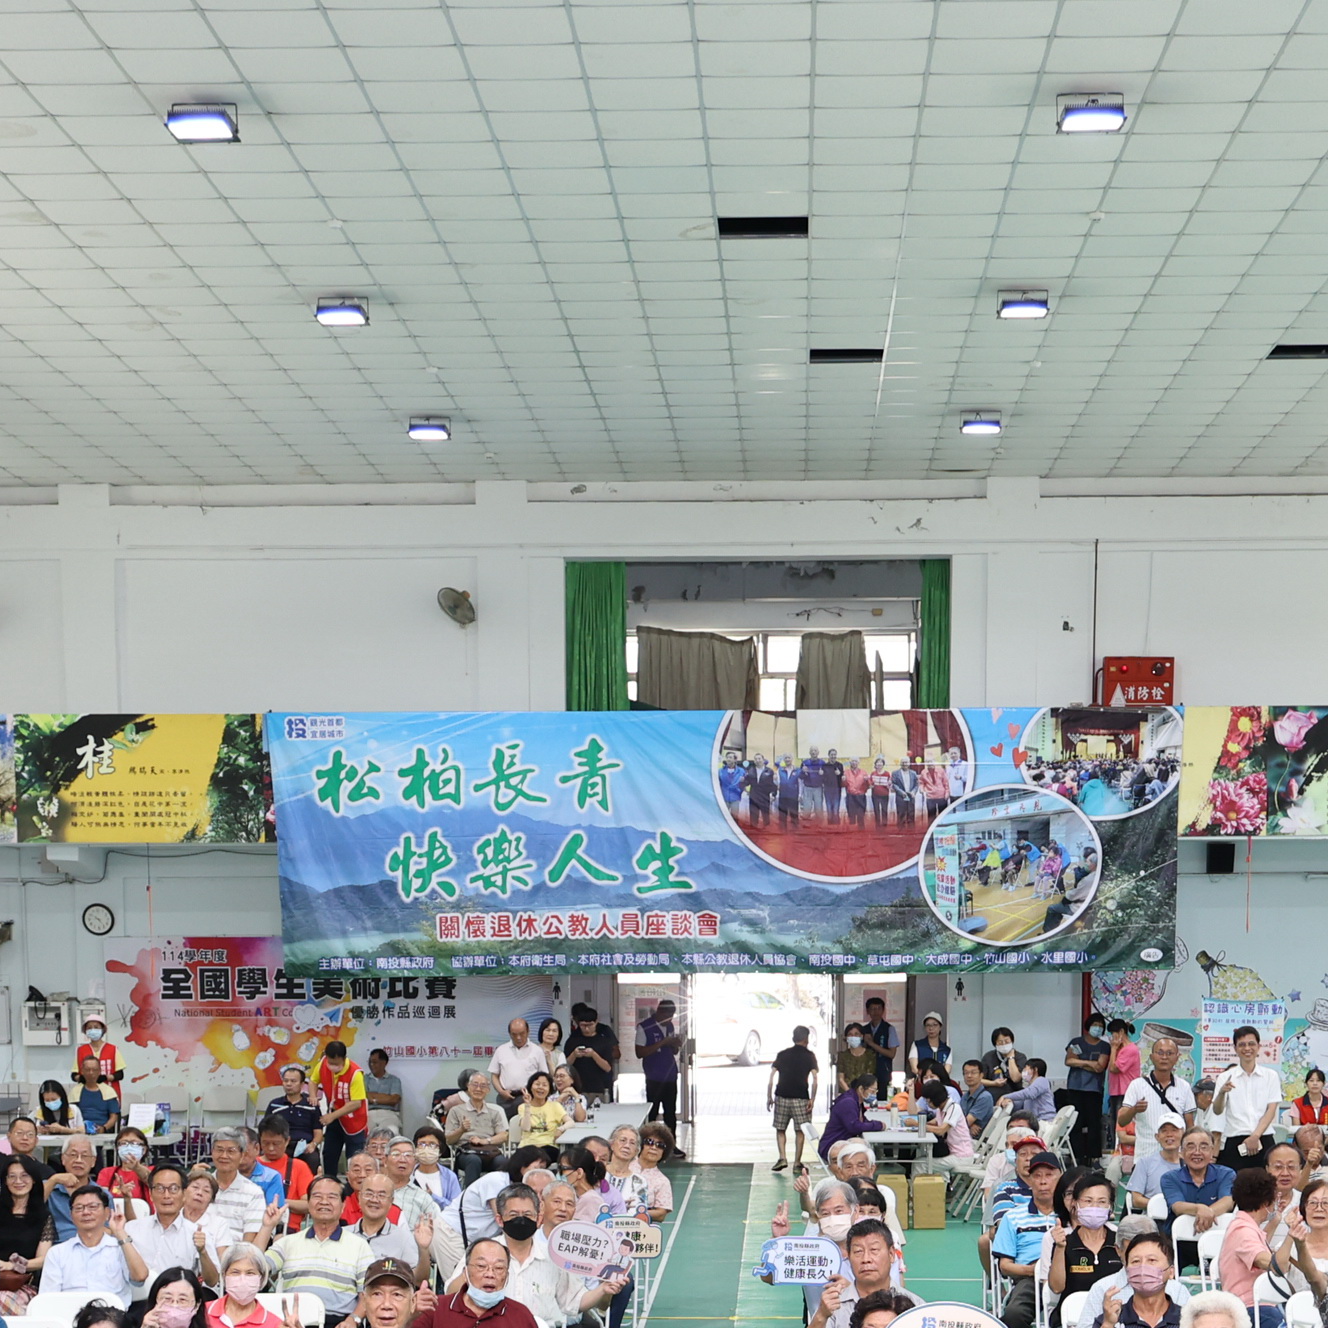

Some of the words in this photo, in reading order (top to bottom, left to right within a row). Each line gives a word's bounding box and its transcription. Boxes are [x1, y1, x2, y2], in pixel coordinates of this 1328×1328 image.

[1124, 686, 1165, 700] 消防栓
[309, 718, 344, 727] 觀光首都
[310, 729, 344, 739] 宜居城市
[76, 734, 116, 779] 桂
[315, 738, 620, 814] 松柏長青
[388, 829, 694, 900] 快樂人生
[436, 913, 720, 939] 關懷退休公教人員座談會
[161, 950, 227, 963] 114學年度
[1142, 950, 1160, 960] 廣告
[160, 967, 457, 1001] 全國學生美術比賽
[174, 1008, 212, 1017] National
[215, 1008, 252, 1017] Student
[255, 1007, 279, 1017] ART
[351, 1005, 457, 1019] 優勝作品巡迴展
[1203, 1003, 1283, 1015] 認識心房顫動
[383, 1046, 498, 1058] 竹山國小第八十一屆畢
[559, 1230, 610, 1249] 職場壓力？
[557, 1242, 604, 1260] EAP解憂！
[783, 1255, 834, 1268] 樂活運動，
